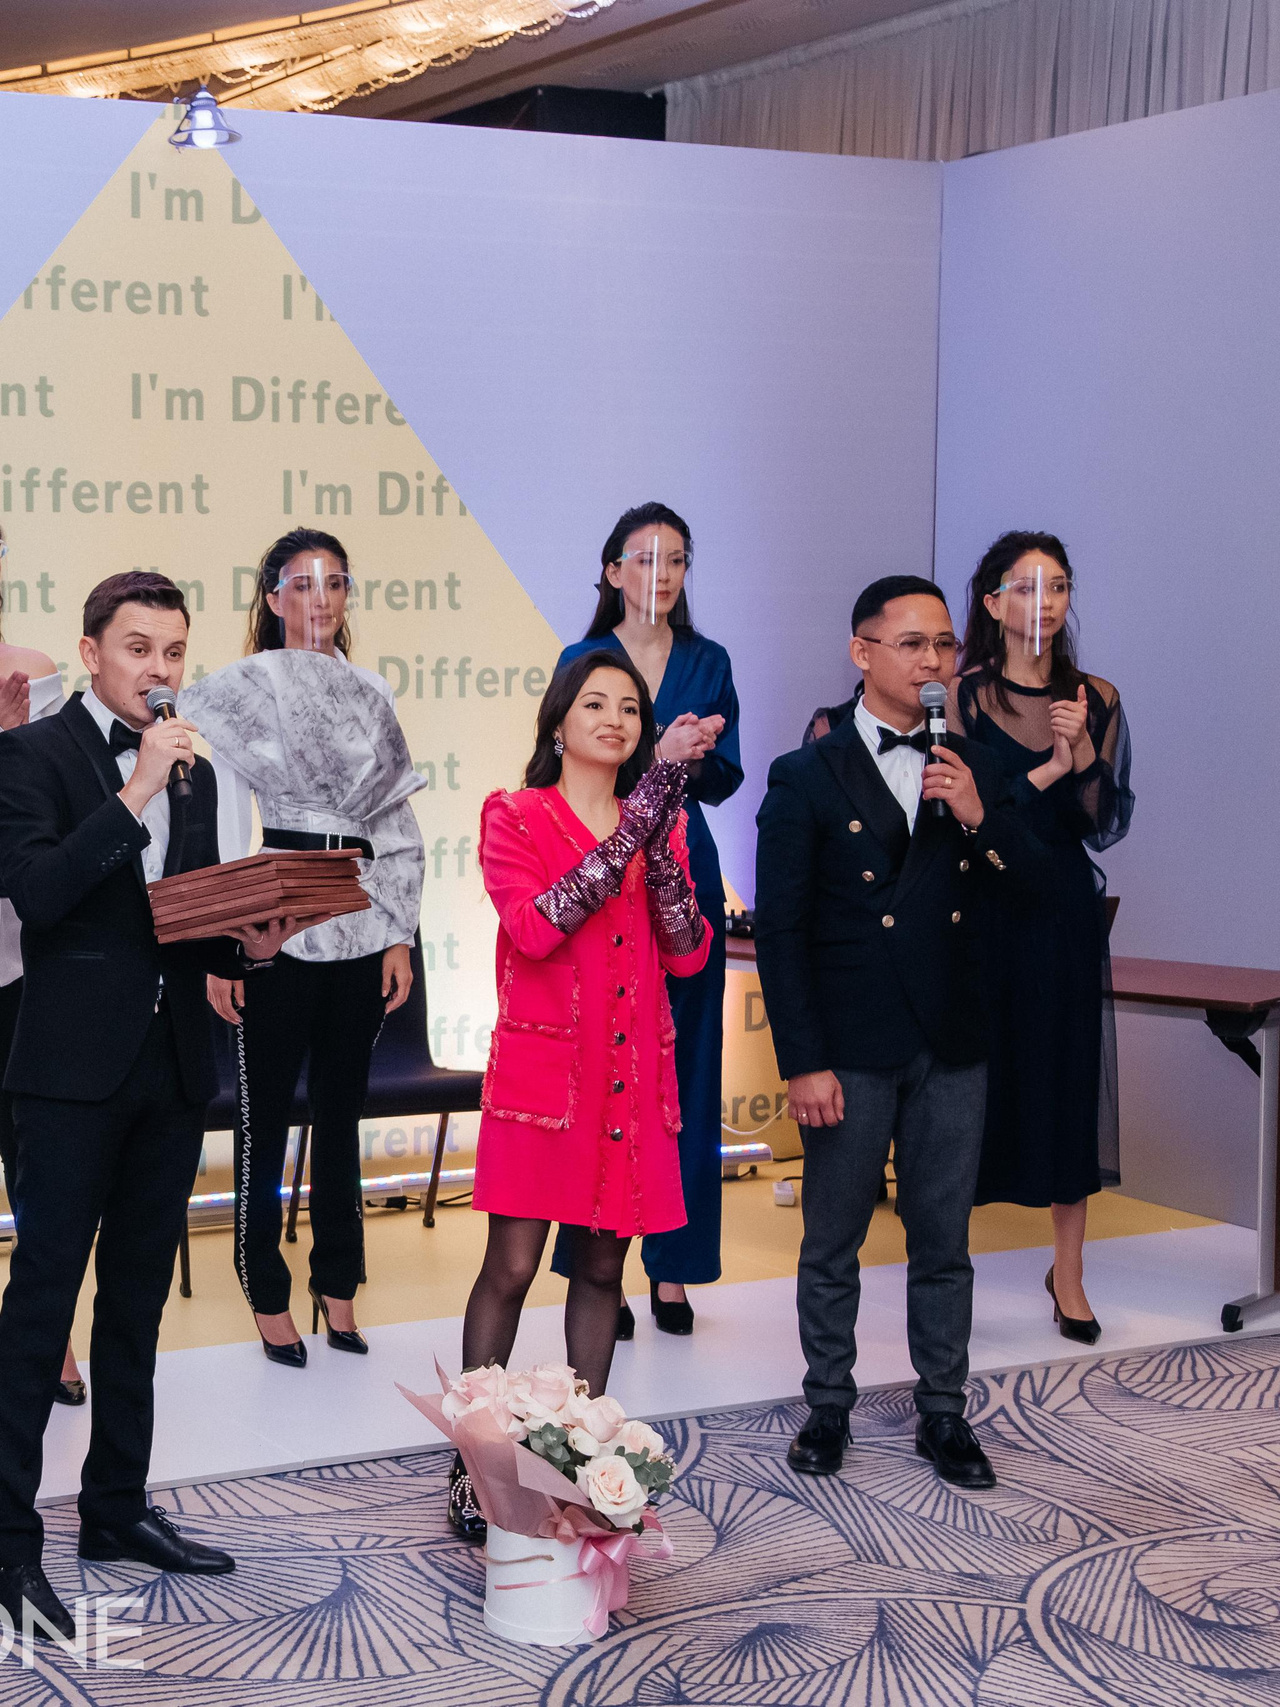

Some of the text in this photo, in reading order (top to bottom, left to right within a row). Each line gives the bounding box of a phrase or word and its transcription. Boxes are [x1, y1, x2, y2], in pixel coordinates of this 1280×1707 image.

[131, 171, 204, 222] I'm
[131, 372, 204, 421] I'm
[283, 469, 352, 515] I'm
[378, 654, 558, 699] Differe
